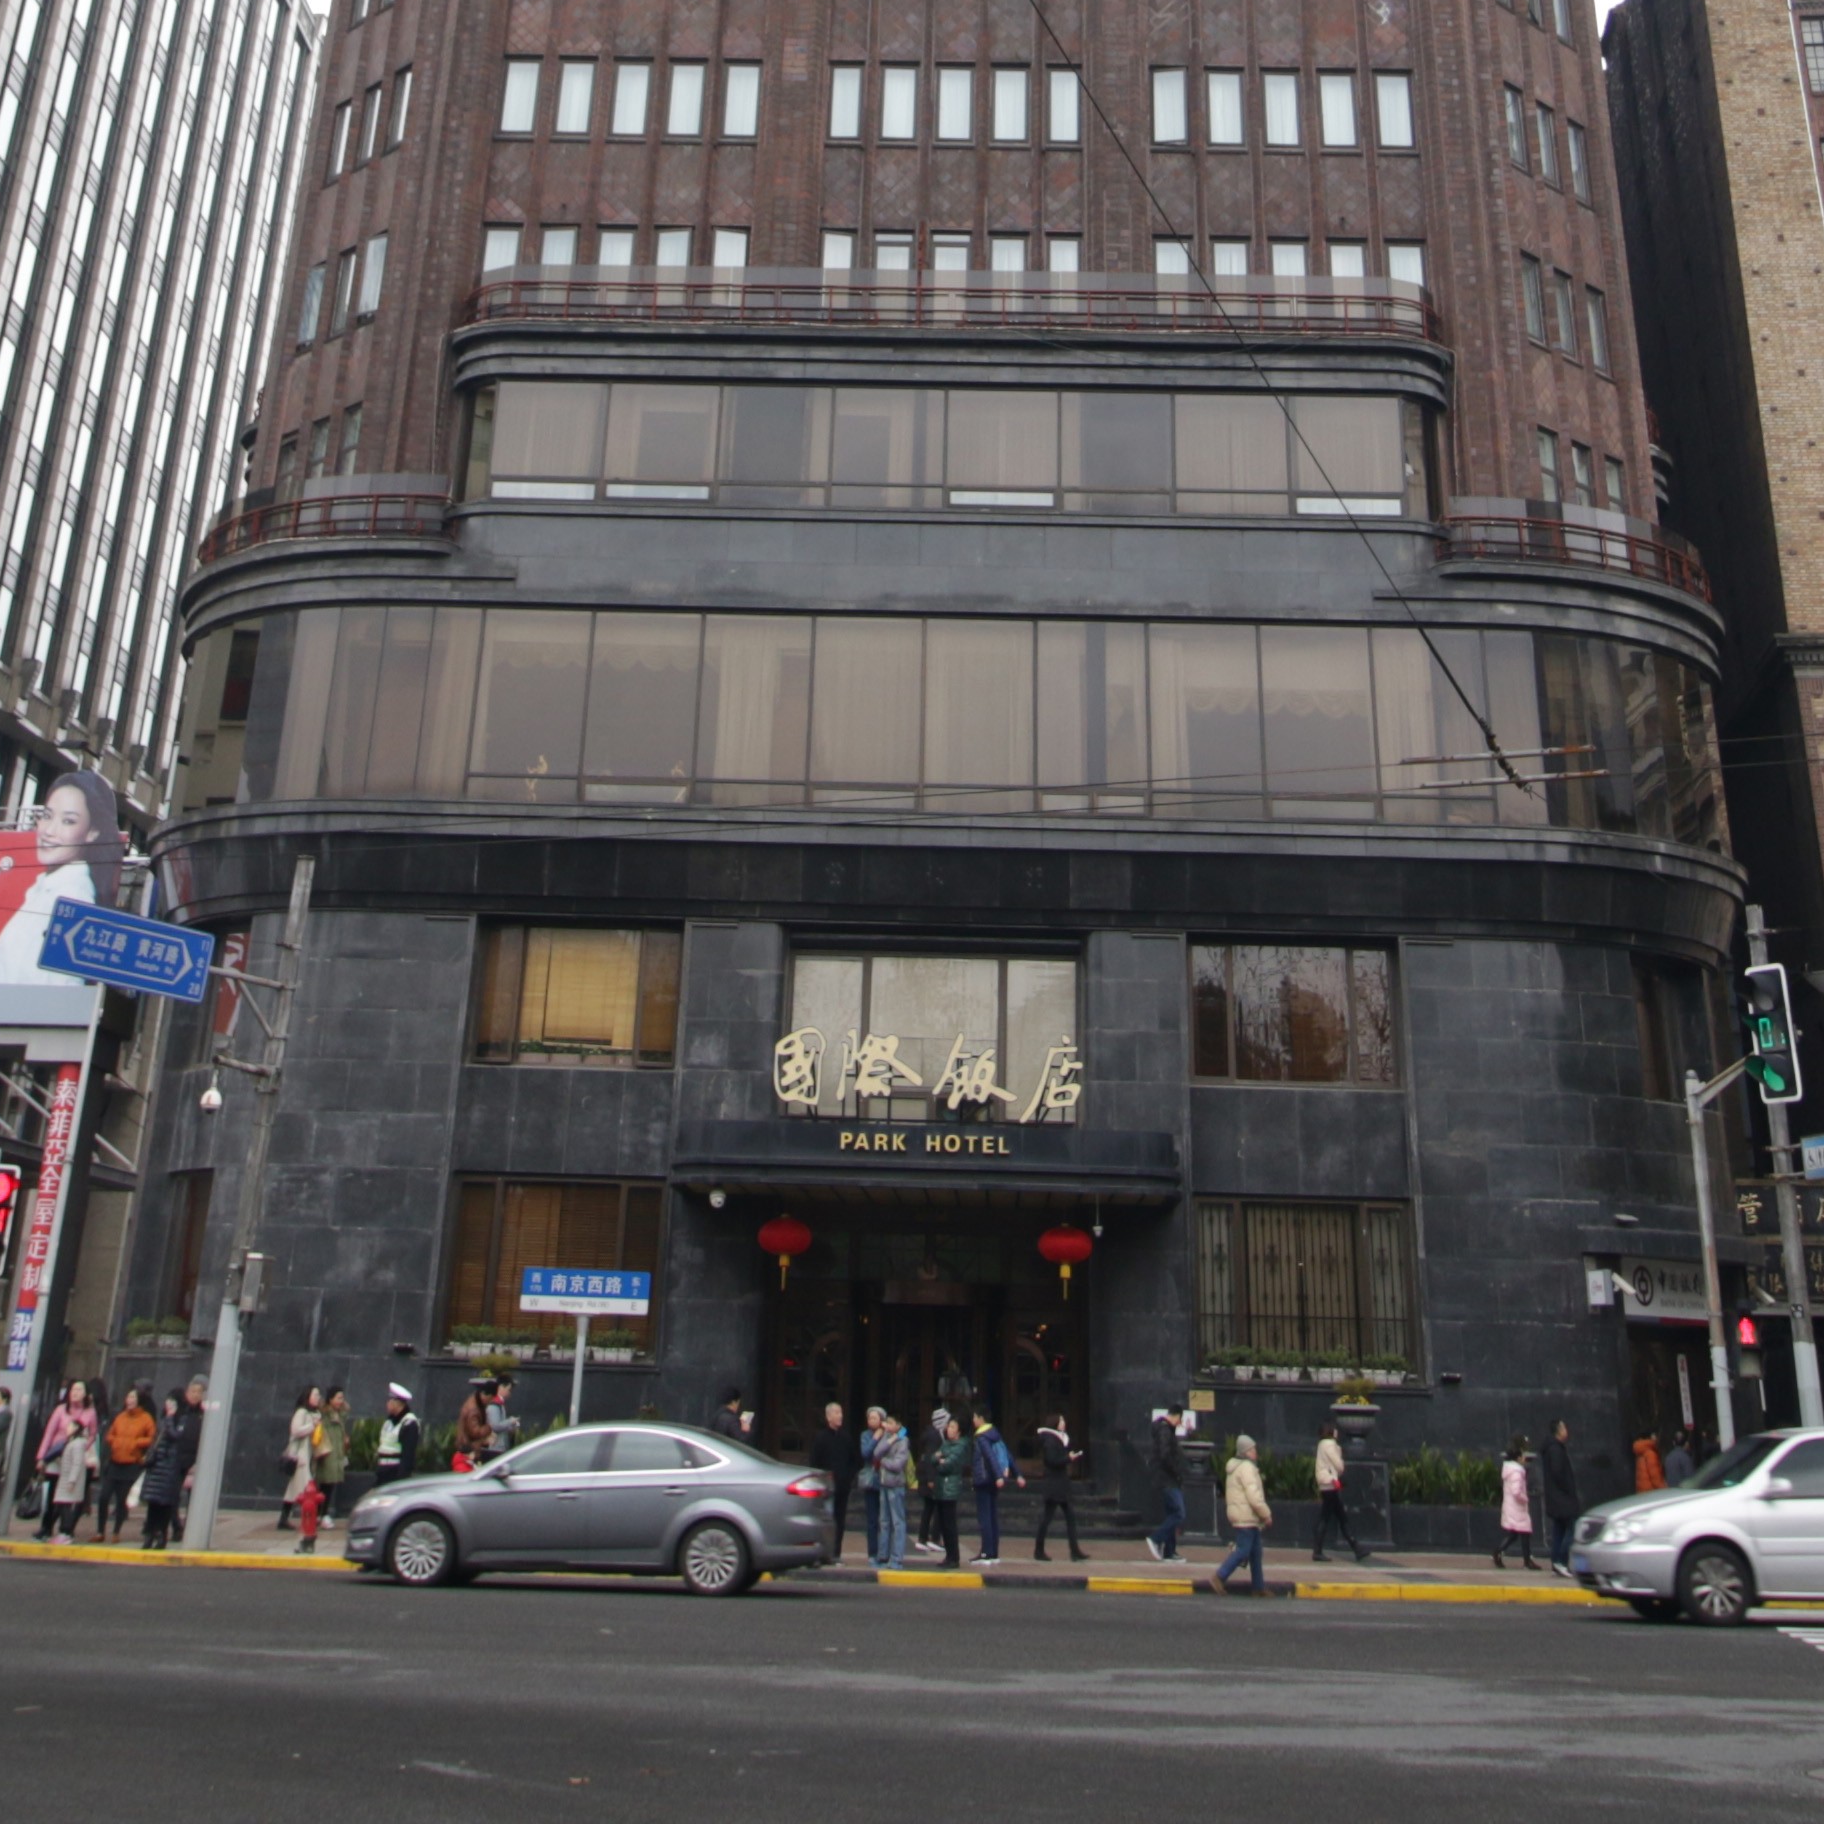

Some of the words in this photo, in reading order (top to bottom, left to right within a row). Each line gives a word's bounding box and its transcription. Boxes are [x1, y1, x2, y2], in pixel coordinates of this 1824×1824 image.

[82, 926, 128, 953] 九江路
[137, 938, 180, 965] 黄河路
[840, 1132, 907, 1153] PARK
[926, 1134, 1011, 1155] HOTEL
[551, 1273, 623, 1294] 南京西路
[529, 1297, 539, 1307] W
